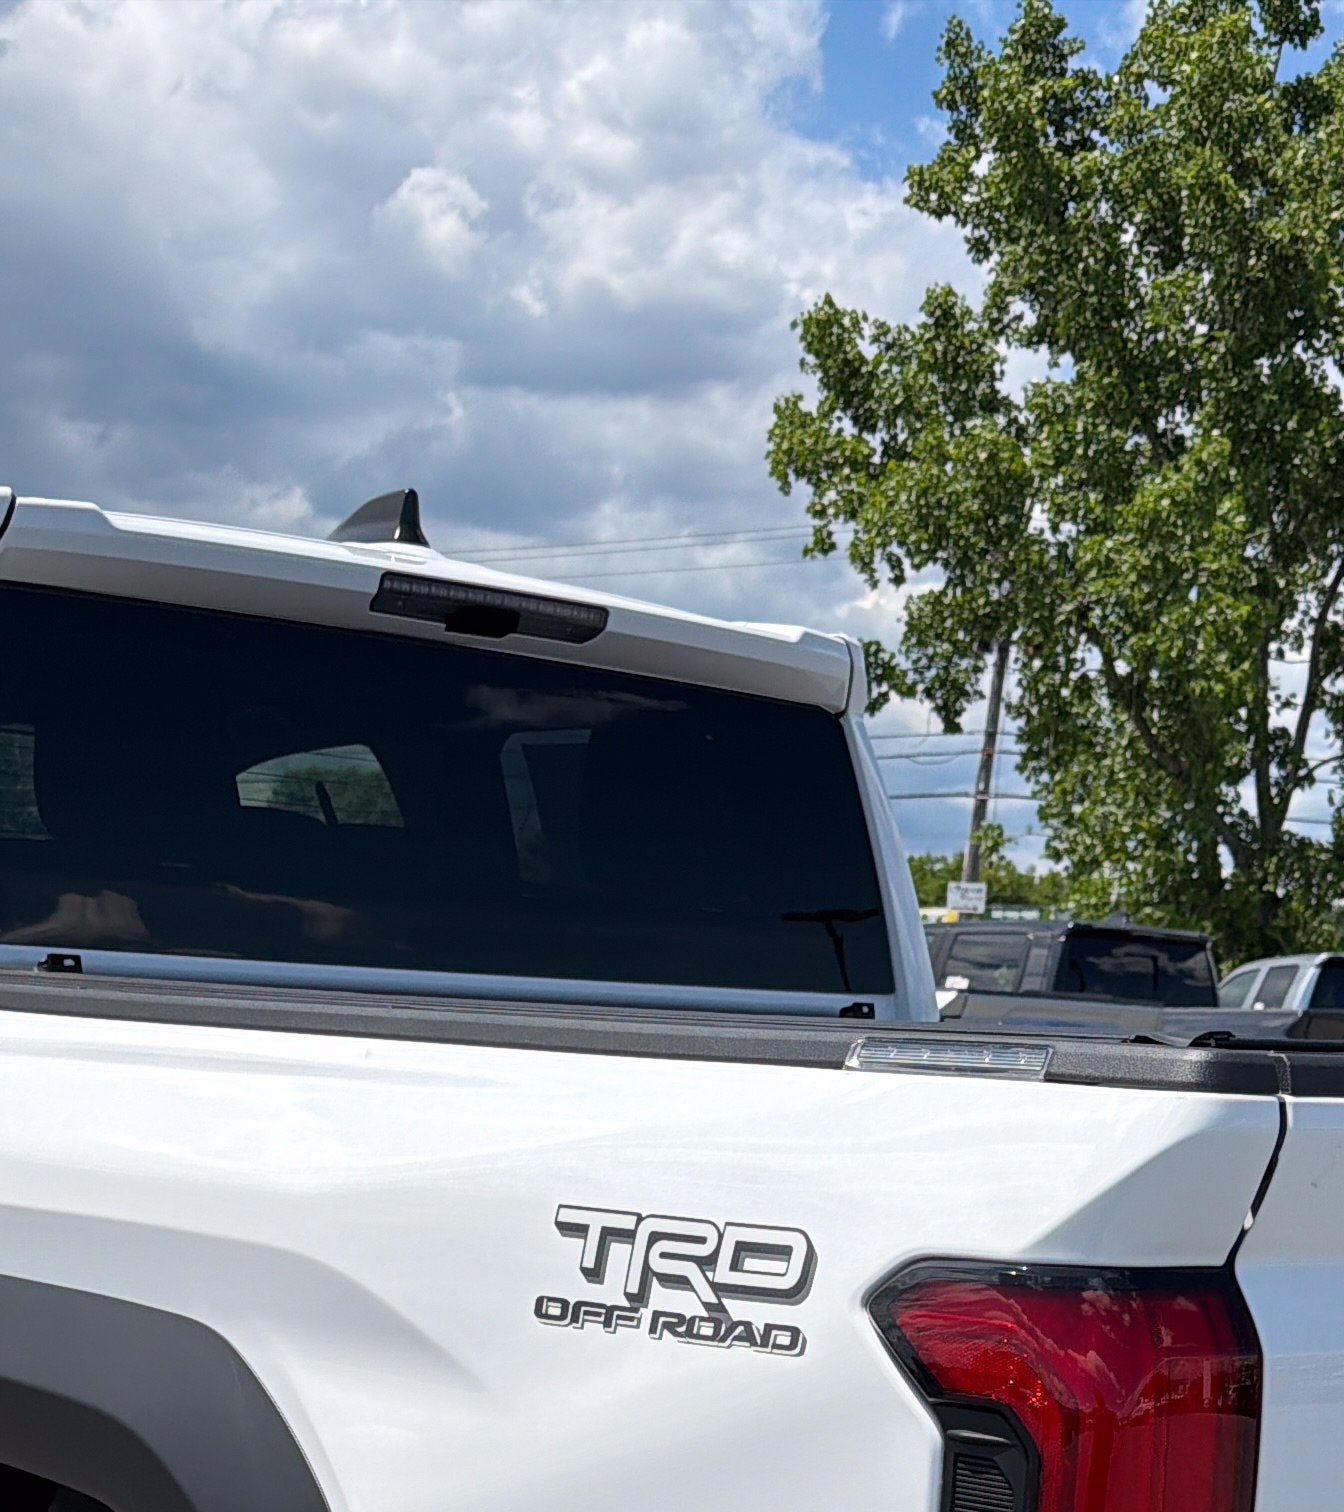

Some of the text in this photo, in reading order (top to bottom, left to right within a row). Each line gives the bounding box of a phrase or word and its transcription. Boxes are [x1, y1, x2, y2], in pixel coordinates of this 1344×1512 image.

[555, 1203, 818, 1318] TRD
[534, 1295, 808, 1357] OFF ROAD
